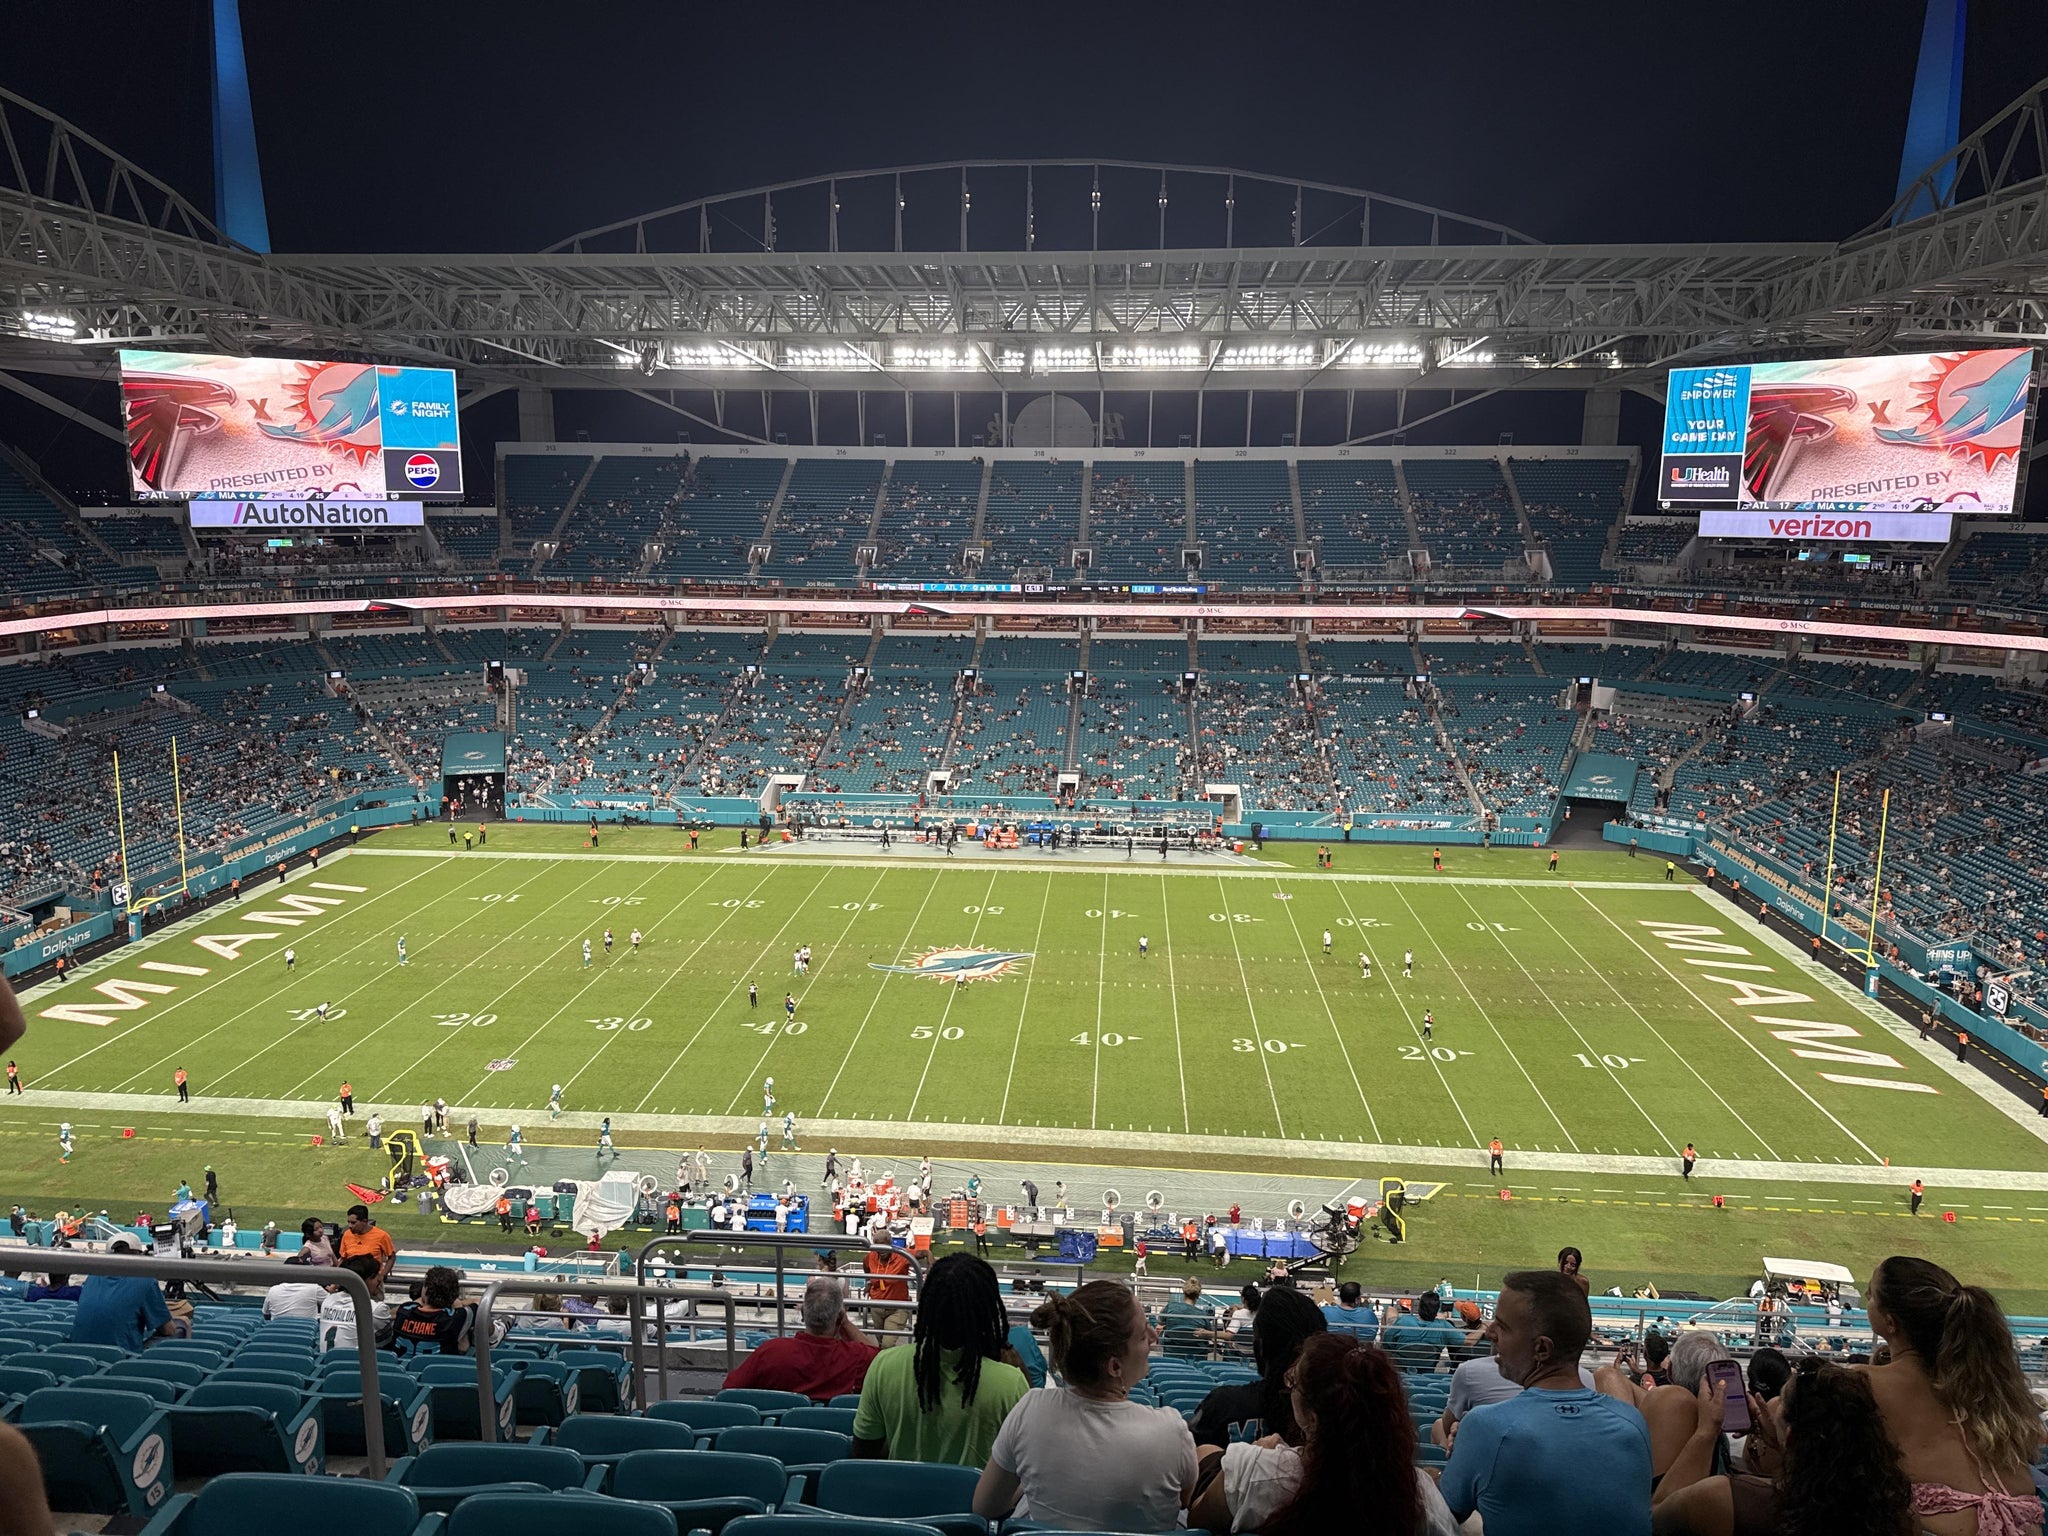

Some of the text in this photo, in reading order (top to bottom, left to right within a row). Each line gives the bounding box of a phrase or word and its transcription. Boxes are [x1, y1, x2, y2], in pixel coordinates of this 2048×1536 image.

[1681, 390, 1736, 400] EMPOWER
[412, 402, 450, 410] FAMILY
[412, 410, 451, 418] NIGHT
[1688, 420, 1724, 429] YOUR
[1672, 431, 1737, 442] GAME DAY
[210, 467, 308, 489] PRESENTED
[311, 464, 334, 477] BY
[408, 467, 437, 475] PEPSI
[1811, 475, 1920, 500] PRESENTED
[1926, 470, 1952, 485] BY
[126, 508, 141, 516] 309
[1769, 515, 1872, 538] verizon
[2008, 523, 2026, 531] 327
[1653, 590, 1693, 598] STEPHENSON
[1861, 601, 1900, 611] RICHMOND
[1790, 622, 1810, 630] MSC
[265, 846, 297, 864] Dolphins
[115, 886, 130, 902] 25
[1775, 896, 1806, 921] Dolphins
[42, 929, 91, 957] Dolphins
[67, 943, 141, 978] TAKES
[145, 925, 189, 946] ALL
[188, 911, 215, 924] OF
[37, 882, 369, 1026] MIAMI
[1927, 949, 1971, 960] PHINS UP
[1637, 920, 1942, 1095] MIAMI
[1990, 987, 2006, 1012] 25
[290, 1008, 347, 1022] 10
[438, 1013, 498, 1027] 20
[597, 1016, 653, 1032] 30
[753, 1021, 808, 1036] 40
[910, 1025, 965, 1041] 50
[1069, 1031, 1124, 1047] 40
[1232, 1038, 1287, 1054] 30
[1397, 1046, 1457, 1062] 20
[1572, 1053, 1630, 1069] 10
[401, 1319, 437, 1336] ACHANE
[325, 1326, 338, 1352] 1
[307, 1461, 316, 1472] 14
[150, 1487, 161, 1501] 15
